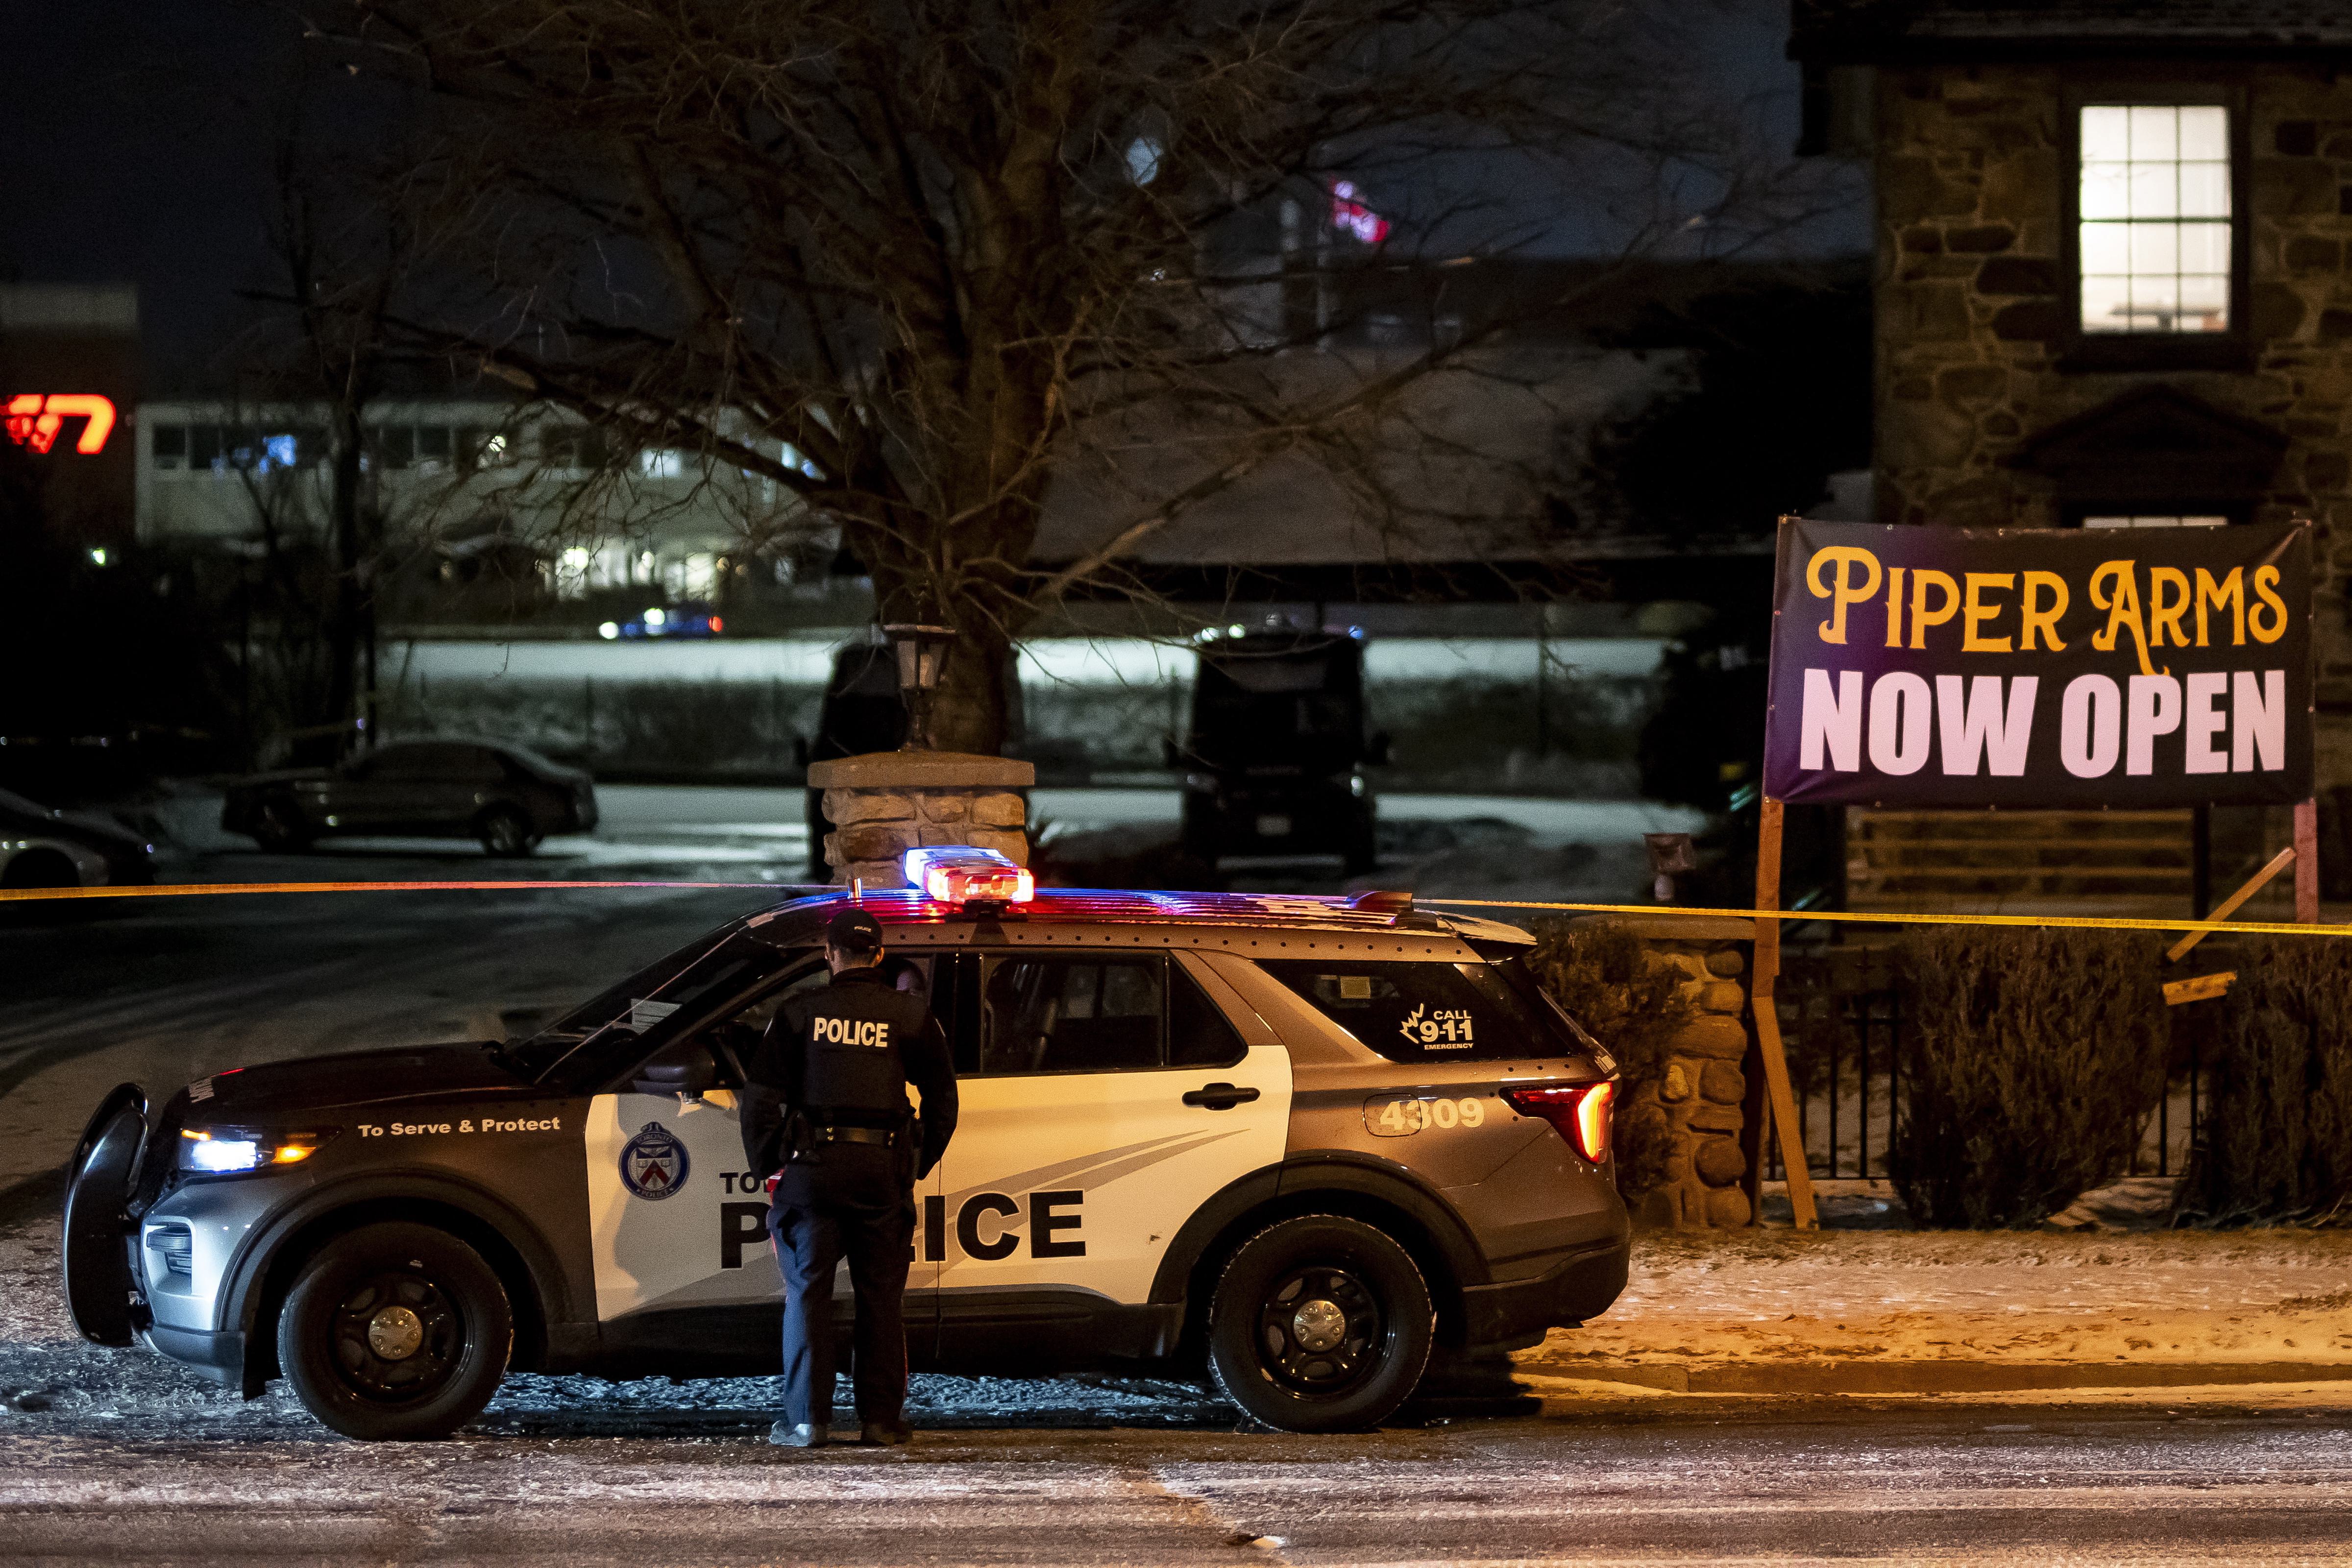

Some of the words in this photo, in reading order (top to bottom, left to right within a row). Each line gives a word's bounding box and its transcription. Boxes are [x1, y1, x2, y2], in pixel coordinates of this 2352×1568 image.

[1806, 546, 2070, 652] PIPER
[2088, 559, 2289, 676] ARMS
[1800, 668, 2039, 777] NOW
[2060, 670, 2286, 778] OPEN
[1420, 1019, 1473, 1042] 9-1-1
[1433, 1010, 1472, 1020] CALL
[813, 1017, 889, 1047] POLICE
[358, 1125, 384, 1137] To
[391, 1122, 451, 1136] Serve
[458, 1119, 474, 1134] &
[482, 1116, 561, 1132] Protect
[1379, 1097, 1485, 1130] 4309
[721, 1190, 1086, 1269] PICE
